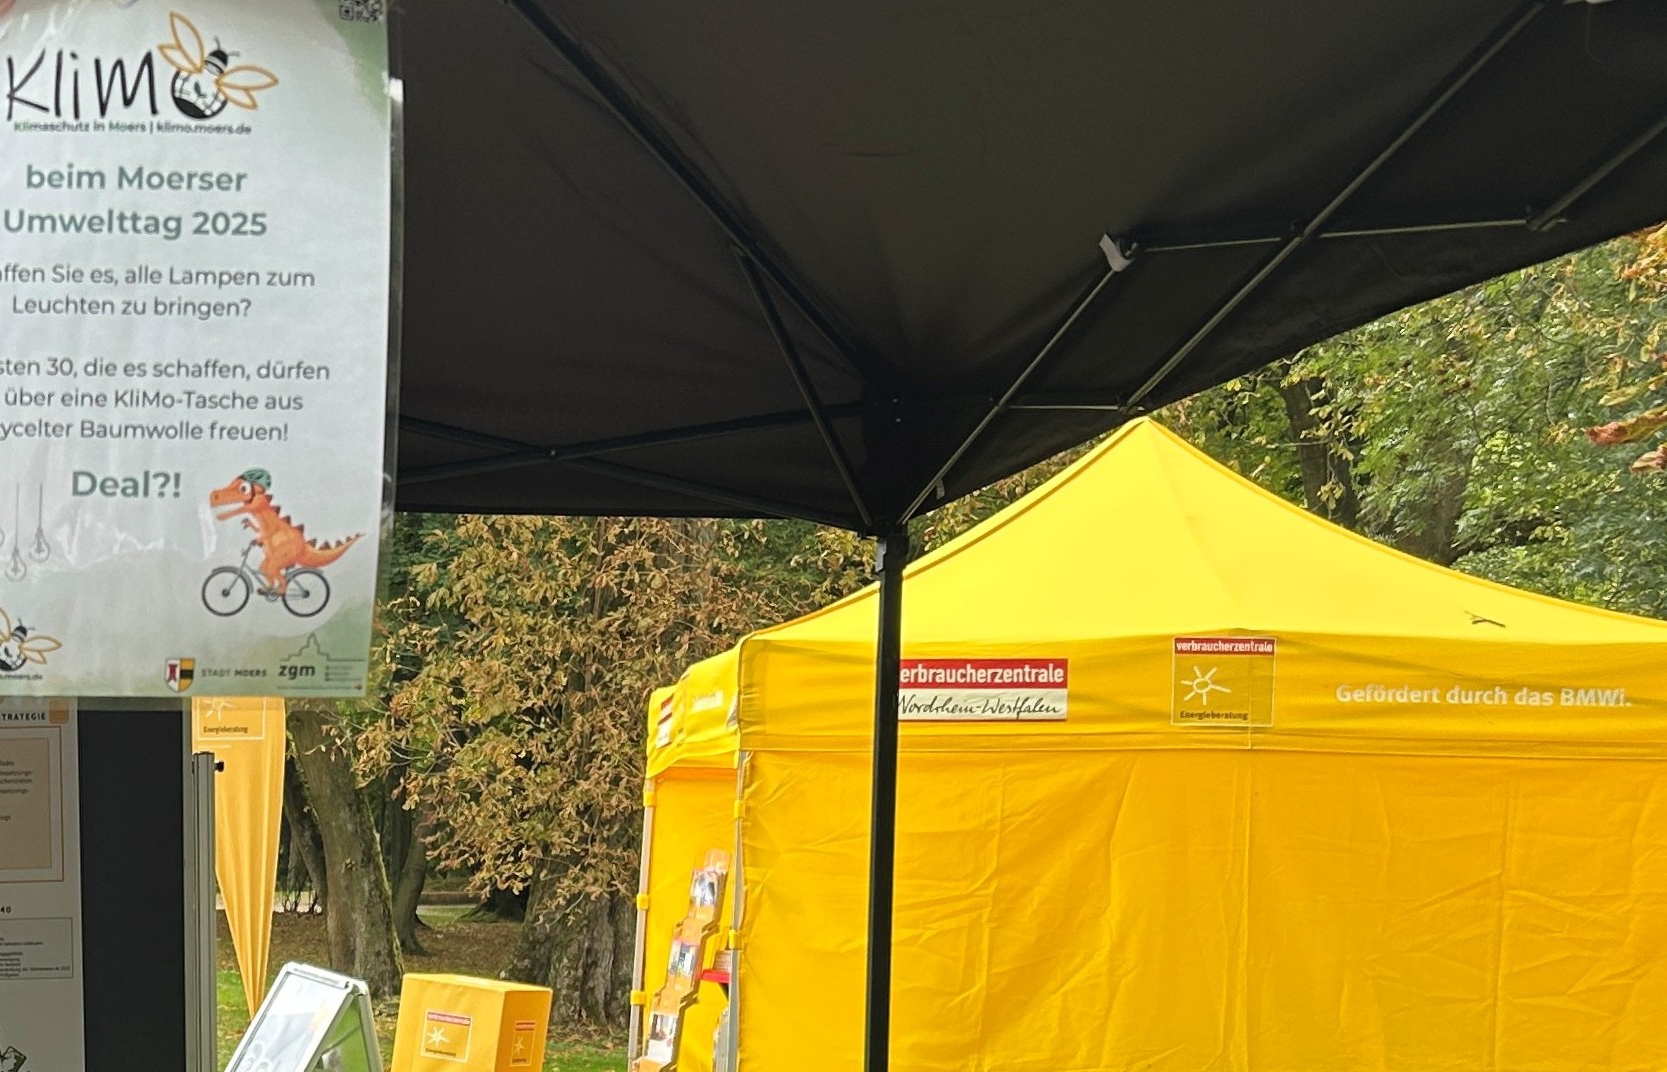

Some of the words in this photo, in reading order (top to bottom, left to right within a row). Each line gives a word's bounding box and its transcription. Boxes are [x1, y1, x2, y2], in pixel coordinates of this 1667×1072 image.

[13, 121, 90, 133] Klimaschutz
[94, 121, 105, 133] in
[109, 122, 147, 134] Moers
[156, 122, 252, 135] klimo.moers.de
[25, 164, 106, 190] beim
[117, 165, 248, 192] Moerser
[3, 209, 182, 240] Umwelttag
[192, 210, 267, 237] 2025
[51, 265, 84, 285] Sie
[90, 269, 119, 288] es,
[125, 265, 162, 286] alle
[169, 266, 260, 291] Lampen
[266, 271, 315, 288] zum
[12, 296, 115, 316] Leuchten
[120, 301, 147, 317] zu
[153, 297, 252, 321] bringen?
[46, 357, 78, 379] 30,
[83, 357, 118, 378] die
[123, 362, 147, 378] es
[152, 358, 251, 382] schaffen,
[256, 360, 330, 381] dürfen
[4, 387, 55, 409] über
[60, 390, 108, 409] eine
[114, 389, 259, 411] KliMo-Tasche
[264, 395, 304, 411] aus
[80, 419, 204, 441] Baumwolle
[209, 421, 289, 442] freuen!
[71, 470, 182, 499] Deal?!
[1175, 640, 1274, 654] verbraucherzentrale
[277, 664, 316, 681] zgm
[899, 663, 1064, 686] erbraucherzentrale
[896, 692, 1062, 719] Nordrhein-Westfalen
[1335, 683, 1440, 704] Gefördert
[1445, 684, 1508, 706] durch
[1513, 687, 1554, 707] das
[1559, 687, 1632, 708] BMWi.
